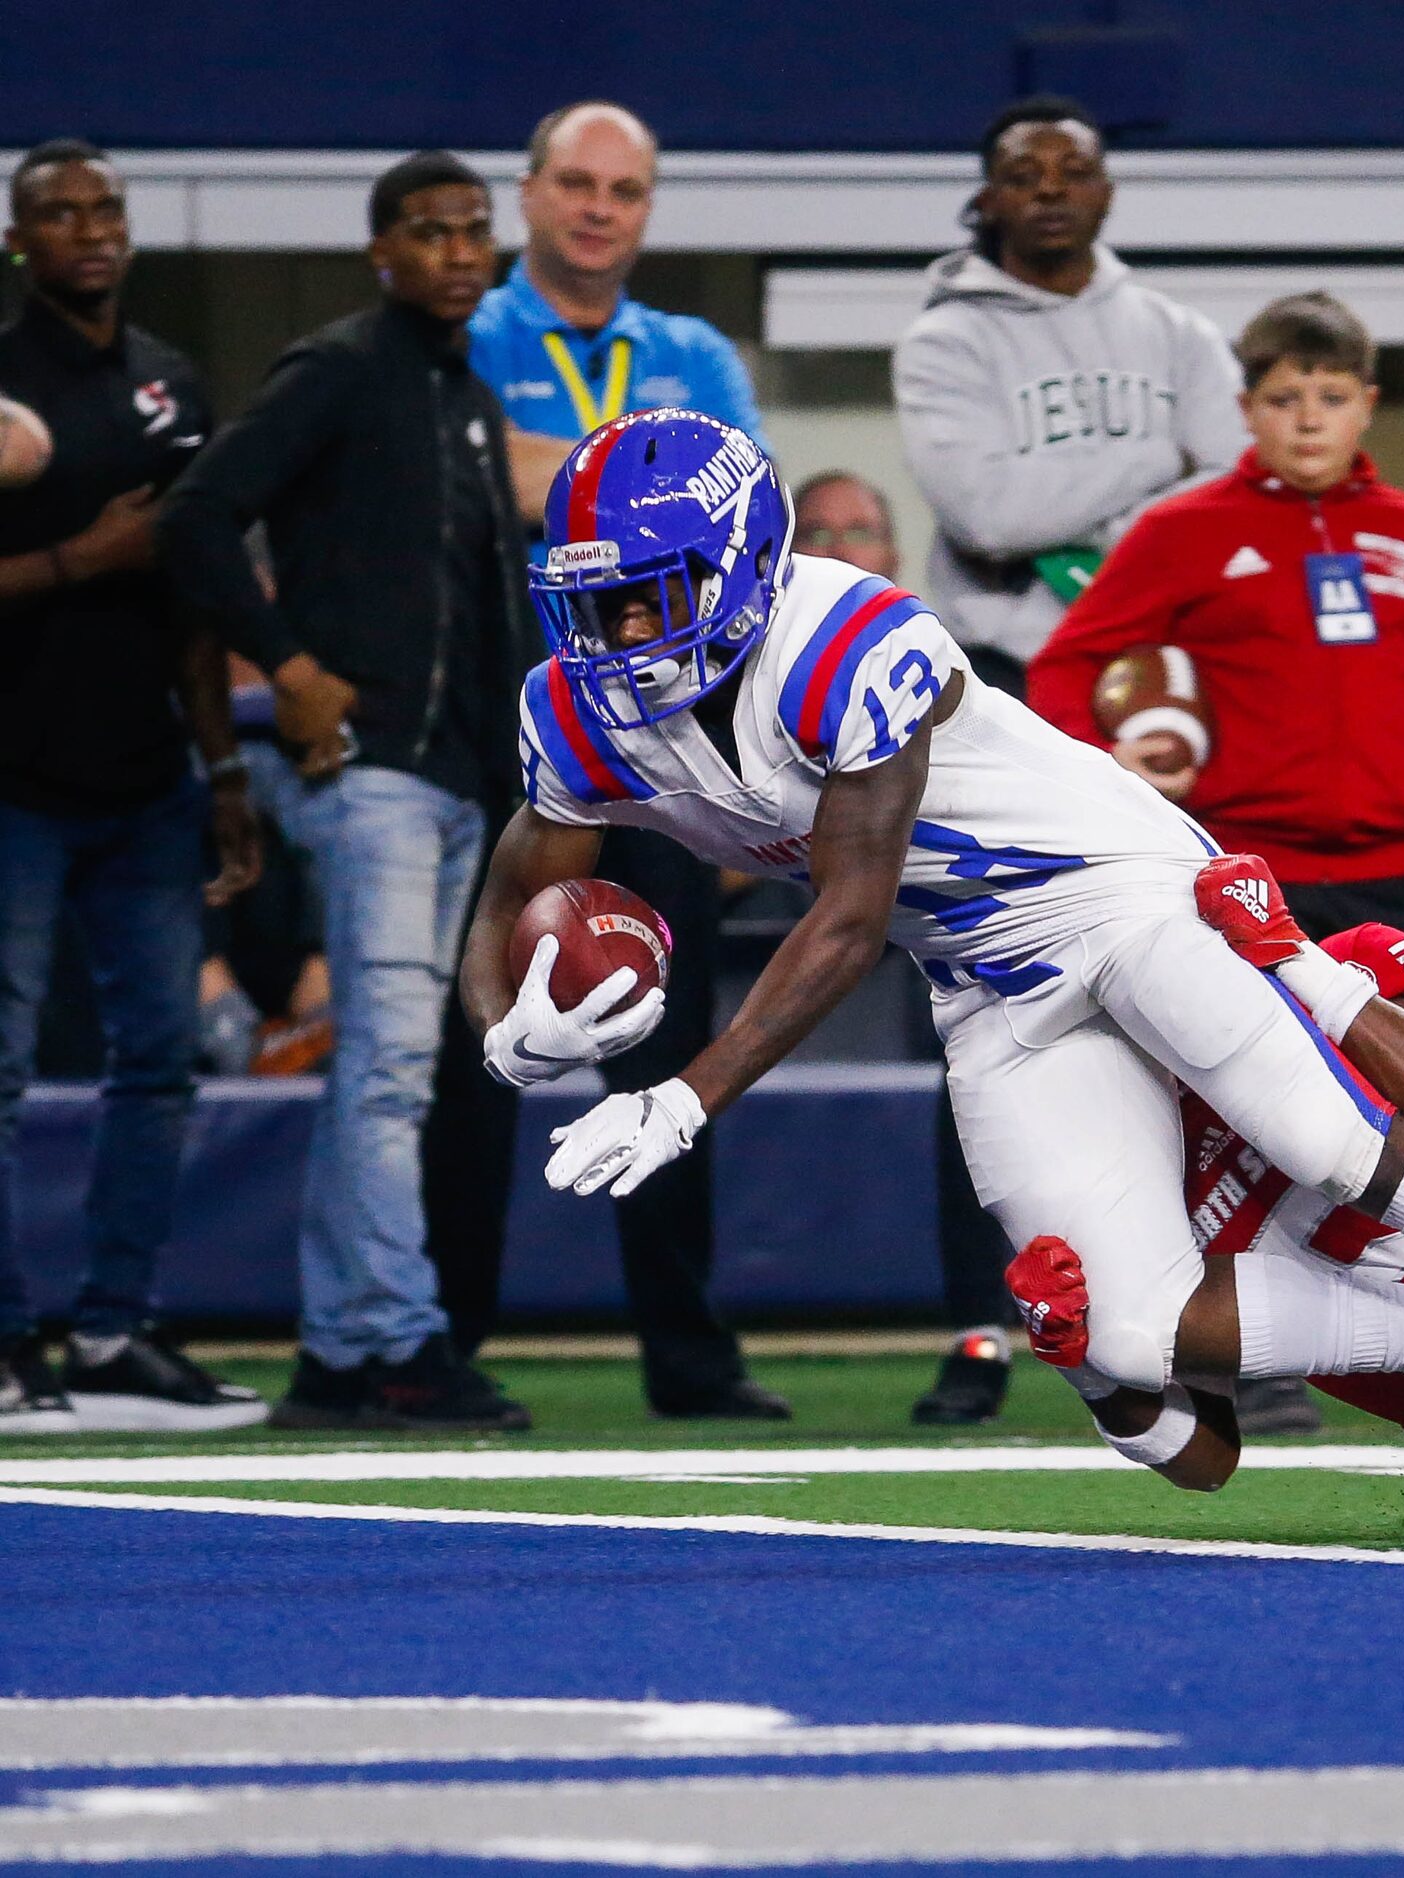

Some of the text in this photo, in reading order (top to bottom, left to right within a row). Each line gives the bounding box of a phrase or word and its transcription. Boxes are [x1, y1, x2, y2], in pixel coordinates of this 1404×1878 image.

[564, 546, 600, 563] Riddell
[863, 648, 941, 763] 13
[1222, 885, 1270, 924] adidas
[1199, 1129, 1236, 1172] adidas
